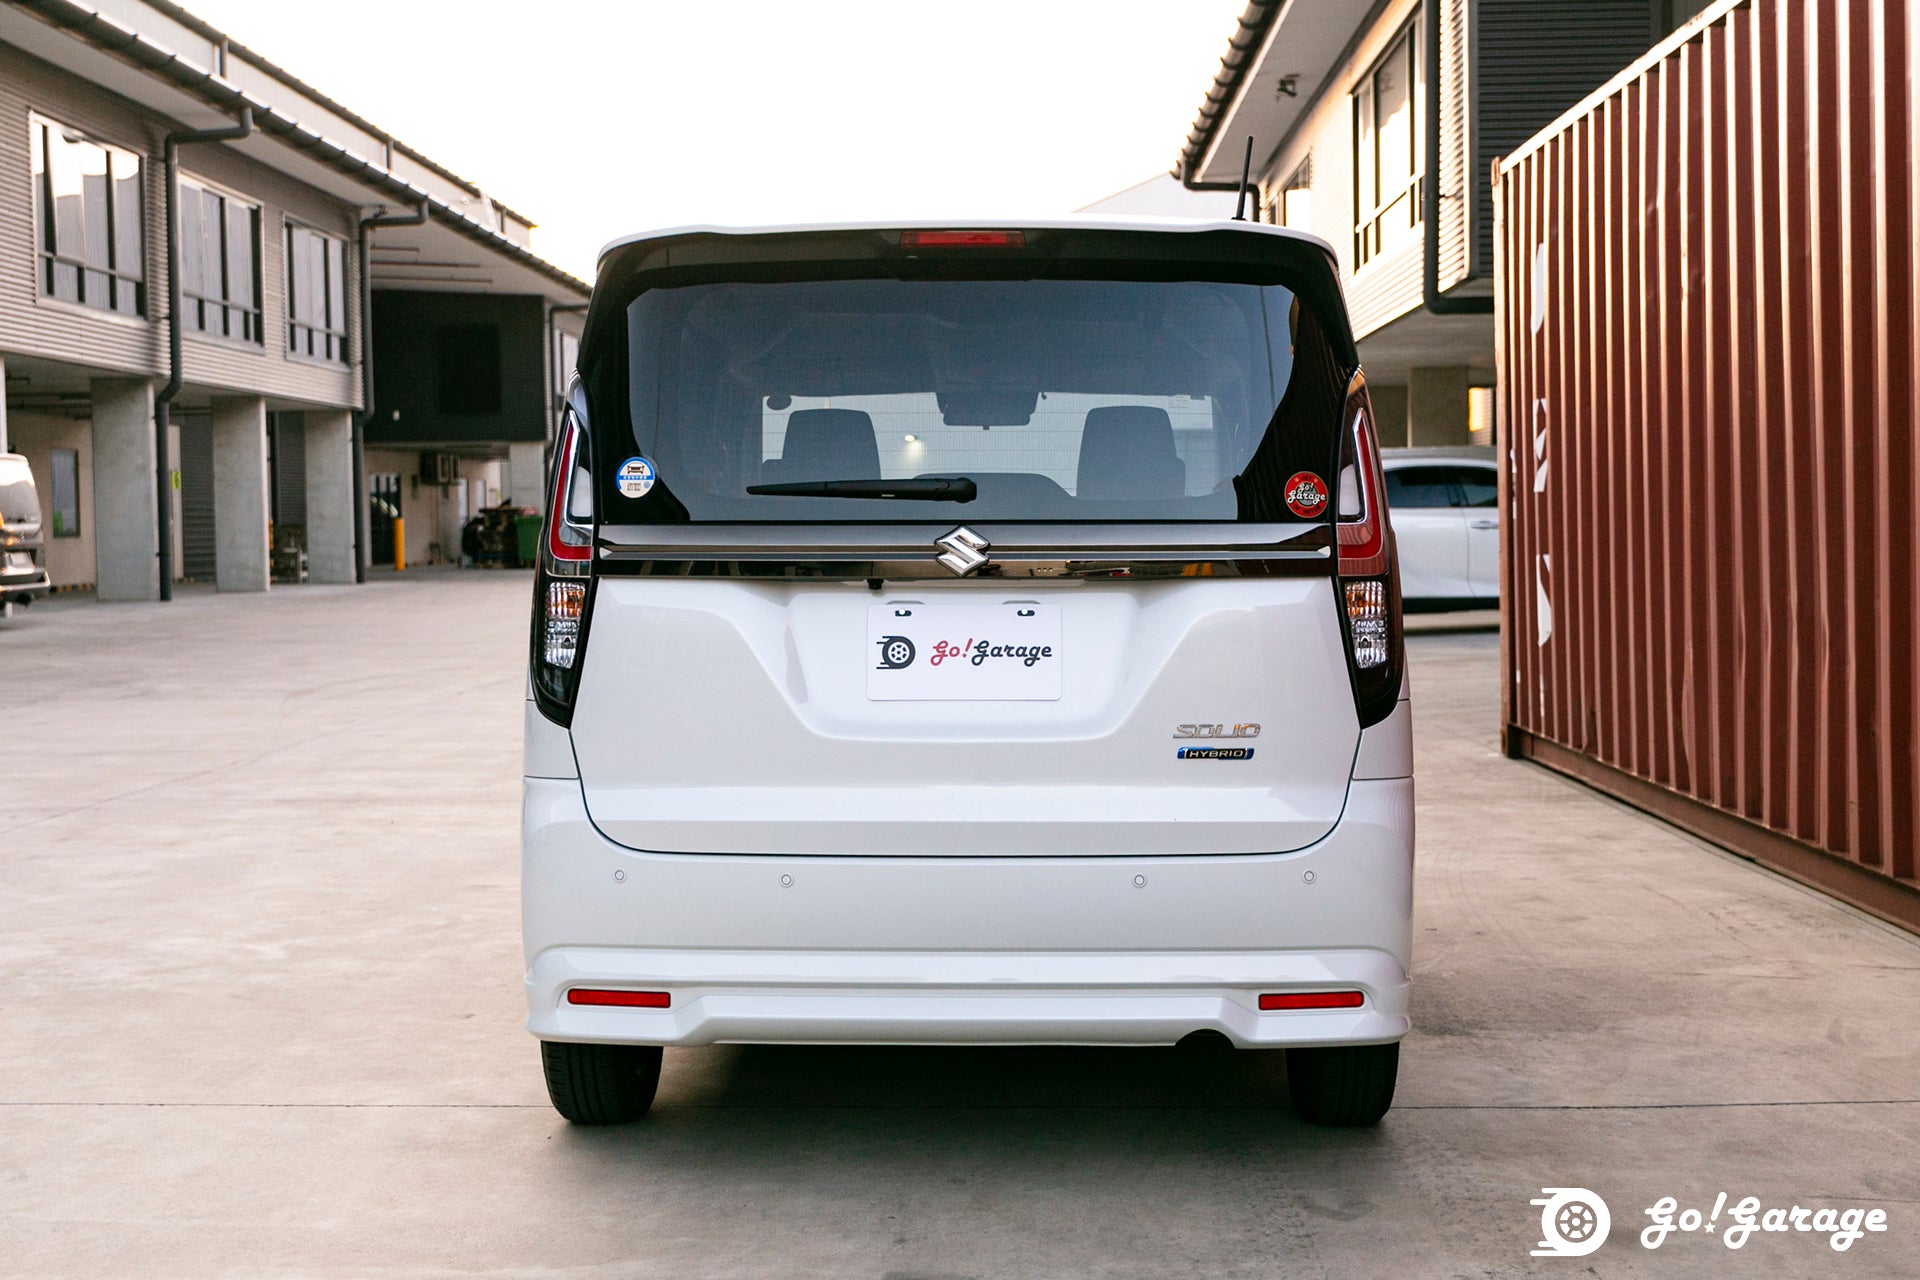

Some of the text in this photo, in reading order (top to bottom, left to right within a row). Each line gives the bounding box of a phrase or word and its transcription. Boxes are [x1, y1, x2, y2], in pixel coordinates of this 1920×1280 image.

[1287, 490, 1326, 505] Garage
[1173, 723, 1261, 738] SOLIO
[1189, 750, 1243, 758] HYBRID
